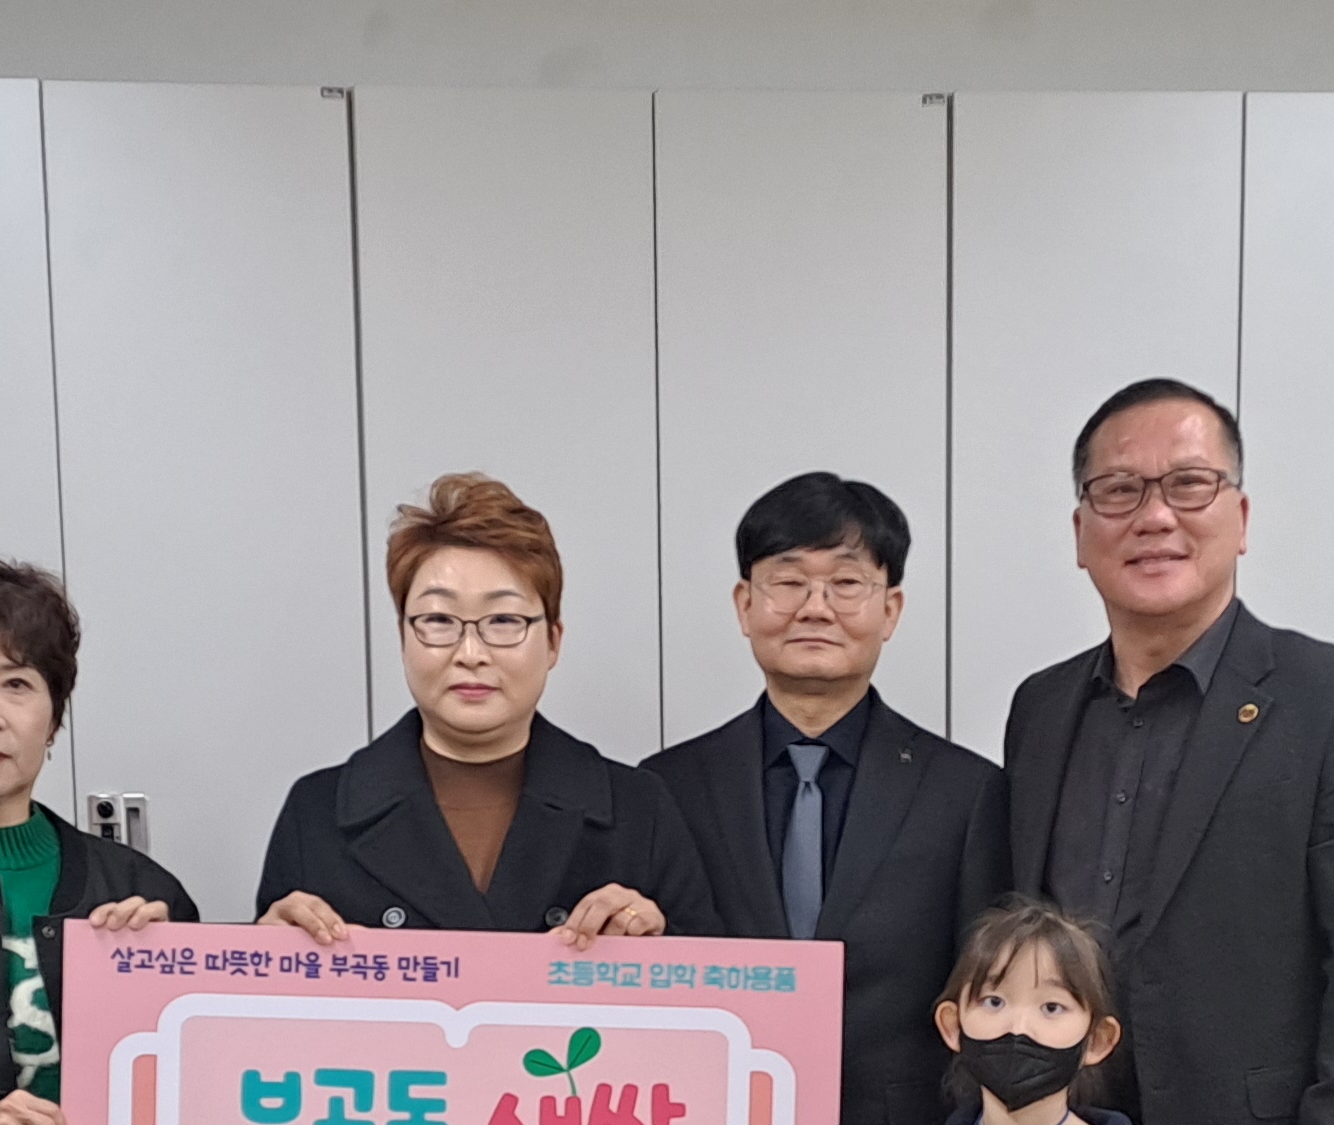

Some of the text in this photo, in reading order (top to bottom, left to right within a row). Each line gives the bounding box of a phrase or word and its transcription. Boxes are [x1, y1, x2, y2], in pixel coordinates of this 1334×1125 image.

[110, 946, 460, 983] 살고싶은 따뜻한 마을 부곡동 만들기
[547, 961, 797, 992] 초등학교 입학 축하용품
